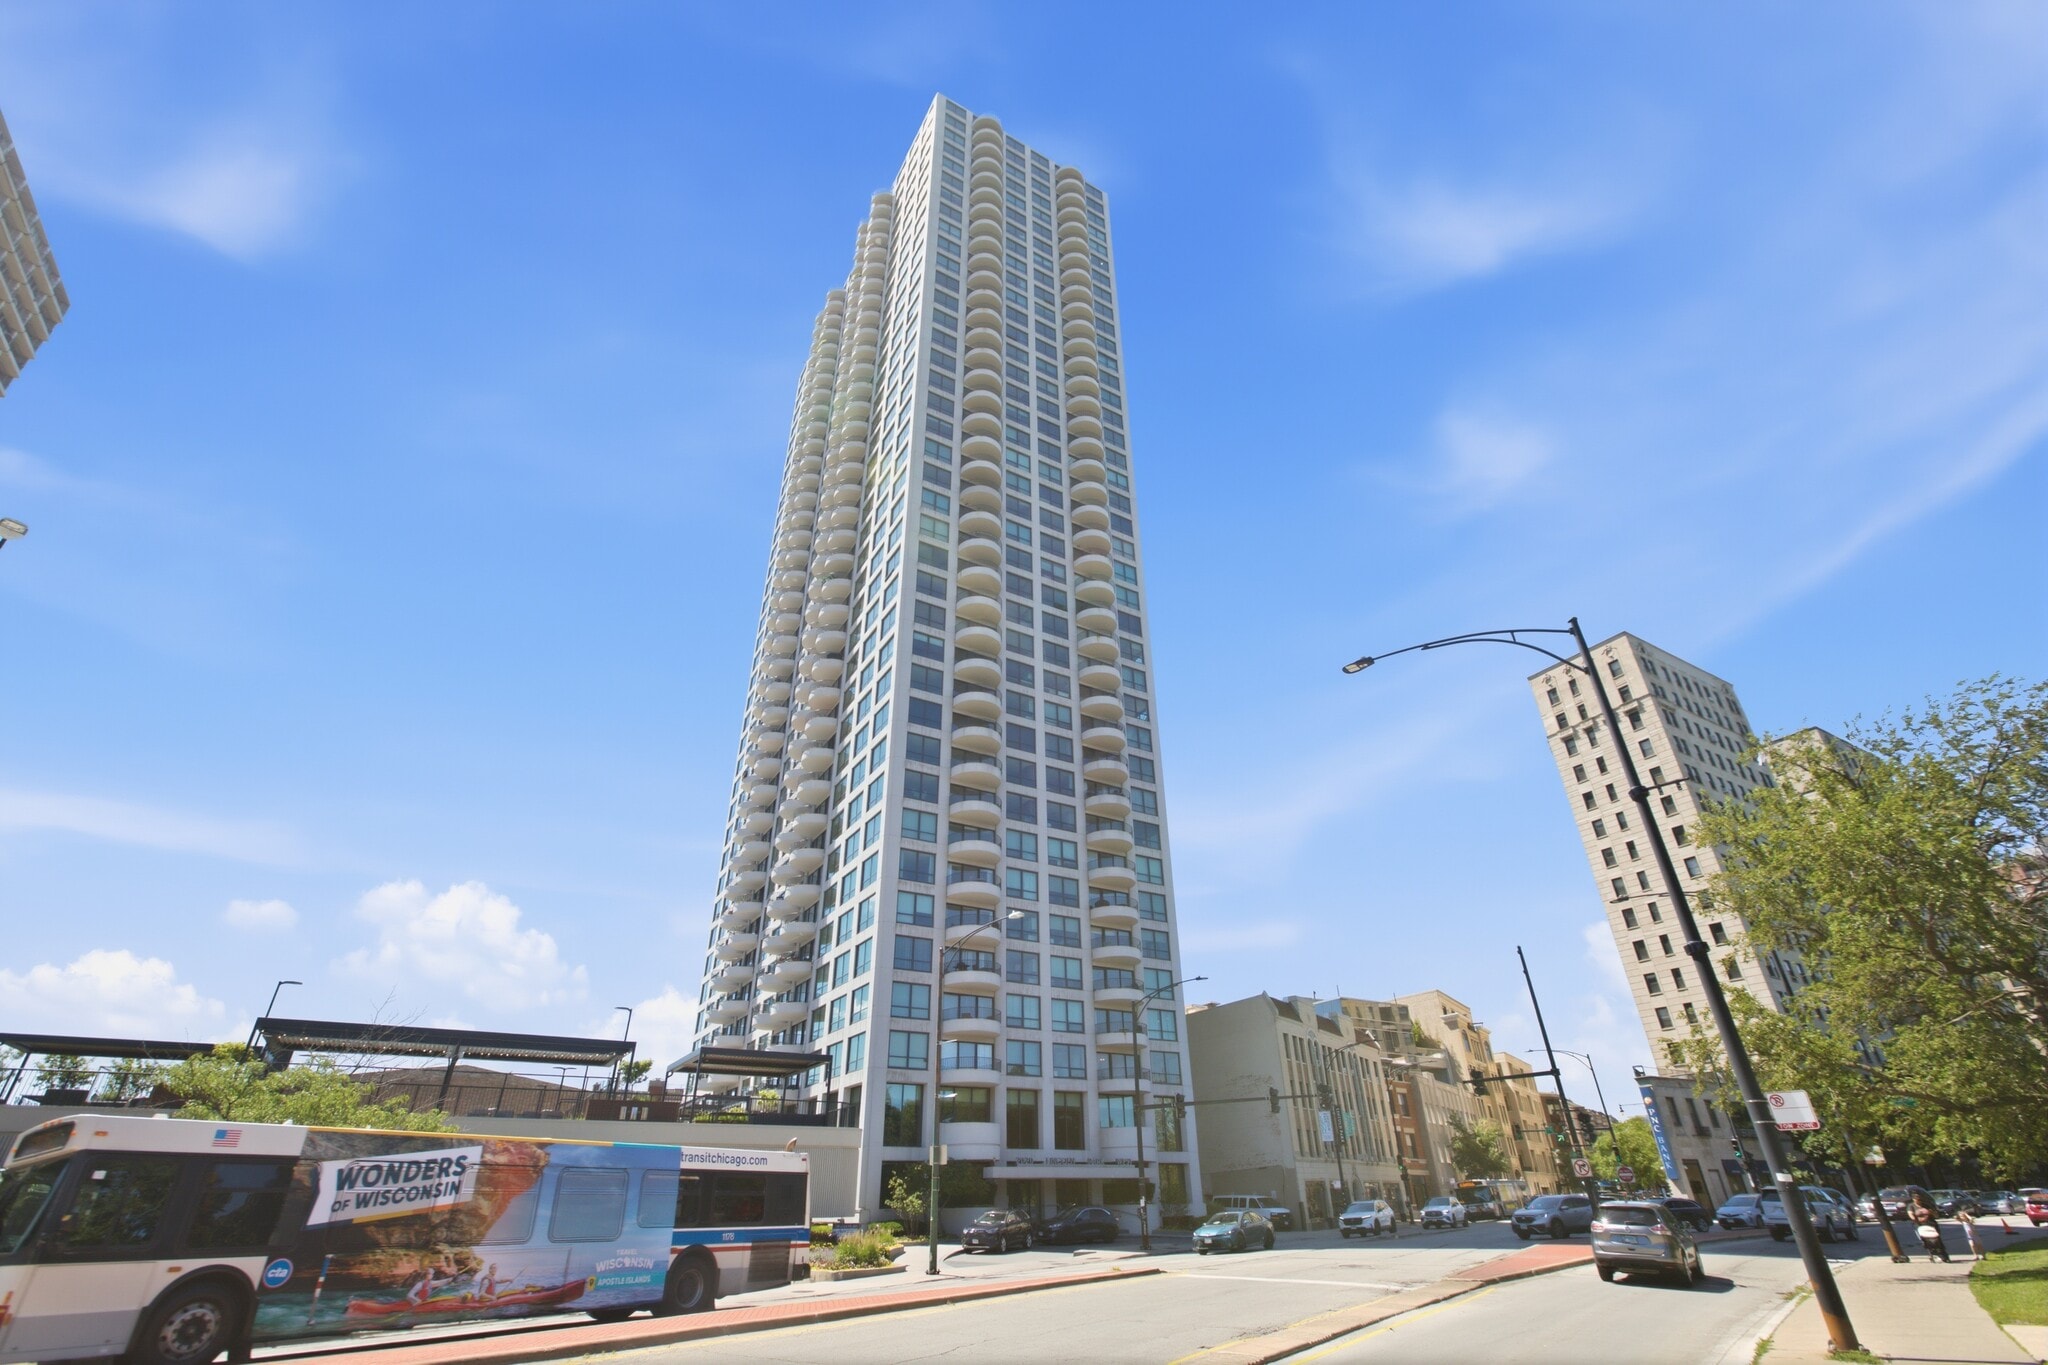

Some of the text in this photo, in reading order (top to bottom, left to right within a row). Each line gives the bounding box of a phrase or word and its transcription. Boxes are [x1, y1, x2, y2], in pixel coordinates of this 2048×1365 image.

[1648, 1108, 1673, 1169] PNC BANK
[681, 1152, 768, 1167] transitchicago.com
[336, 1155, 469, 1191] WONDERS
[331, 1180, 462, 1213] OF WISCONSIN
[268, 1267, 288, 1278] cta
[597, 1274, 651, 1286] APOSTLE ISLANDS
